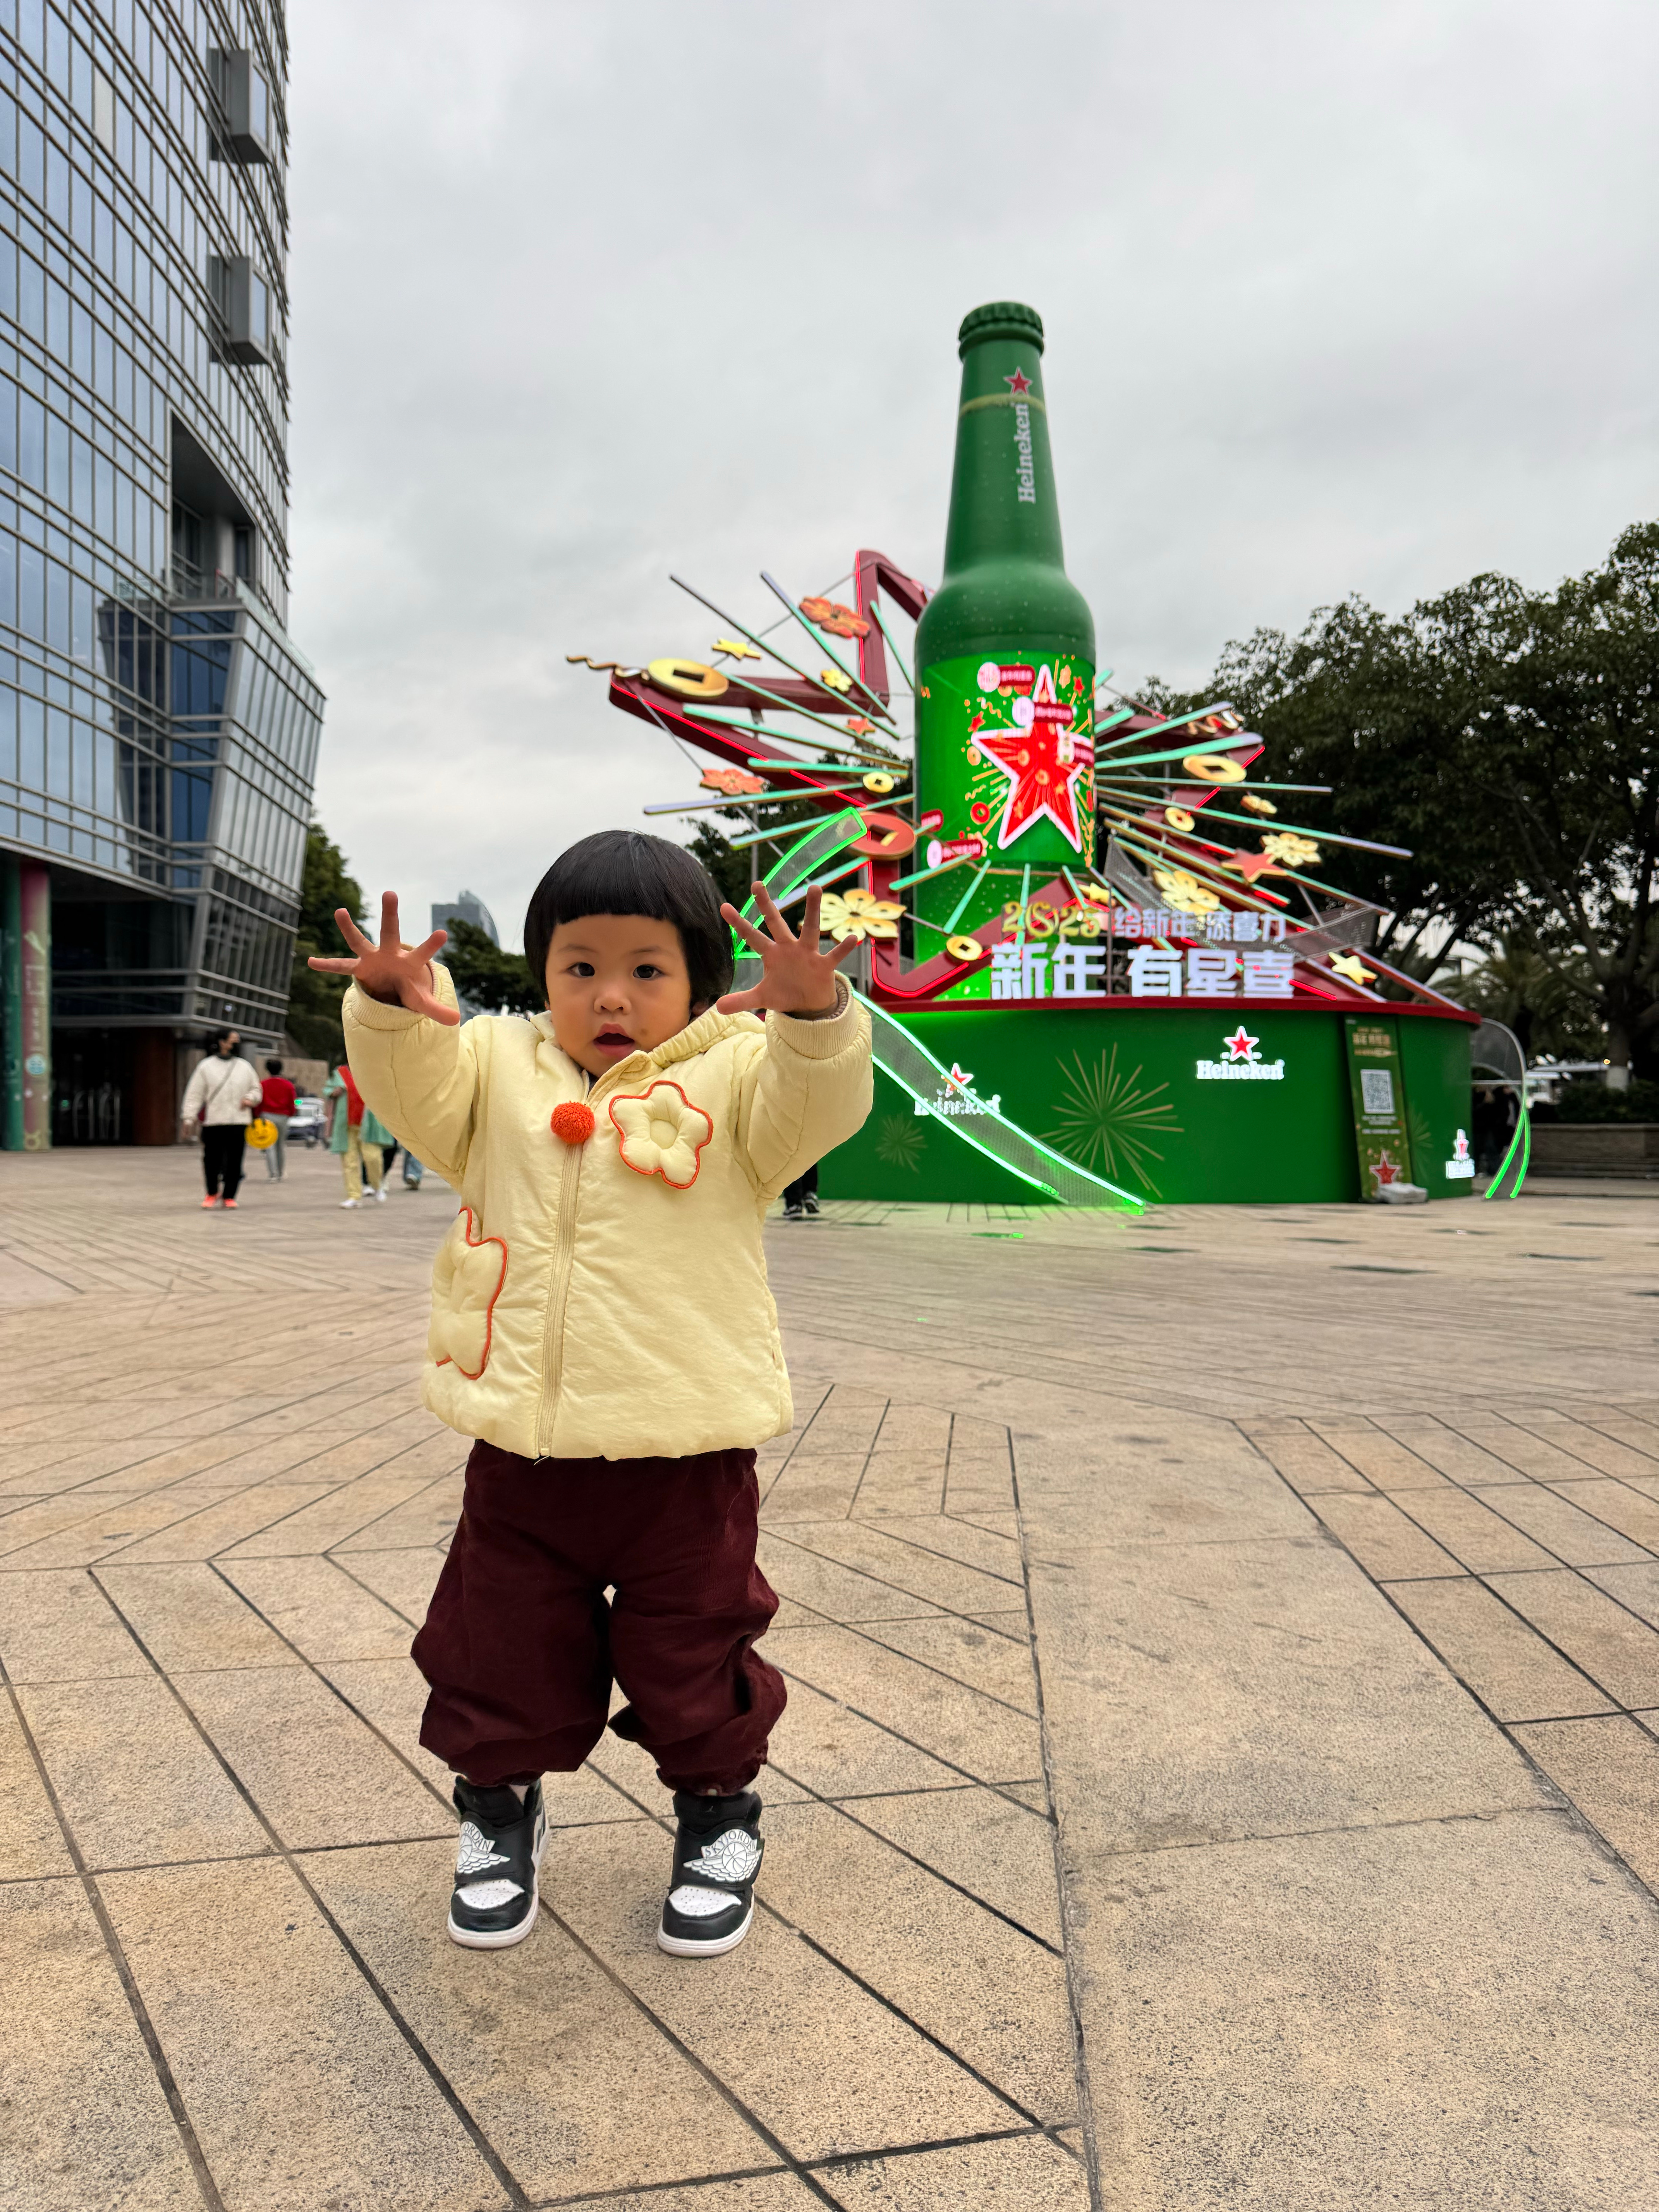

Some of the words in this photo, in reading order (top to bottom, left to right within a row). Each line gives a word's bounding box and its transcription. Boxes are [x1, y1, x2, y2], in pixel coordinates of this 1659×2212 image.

[1013, 403, 1036, 504] Heineken
[1196, 1059, 1285, 1080] Heineken
[464, 1822, 491, 1850] ORDAN
